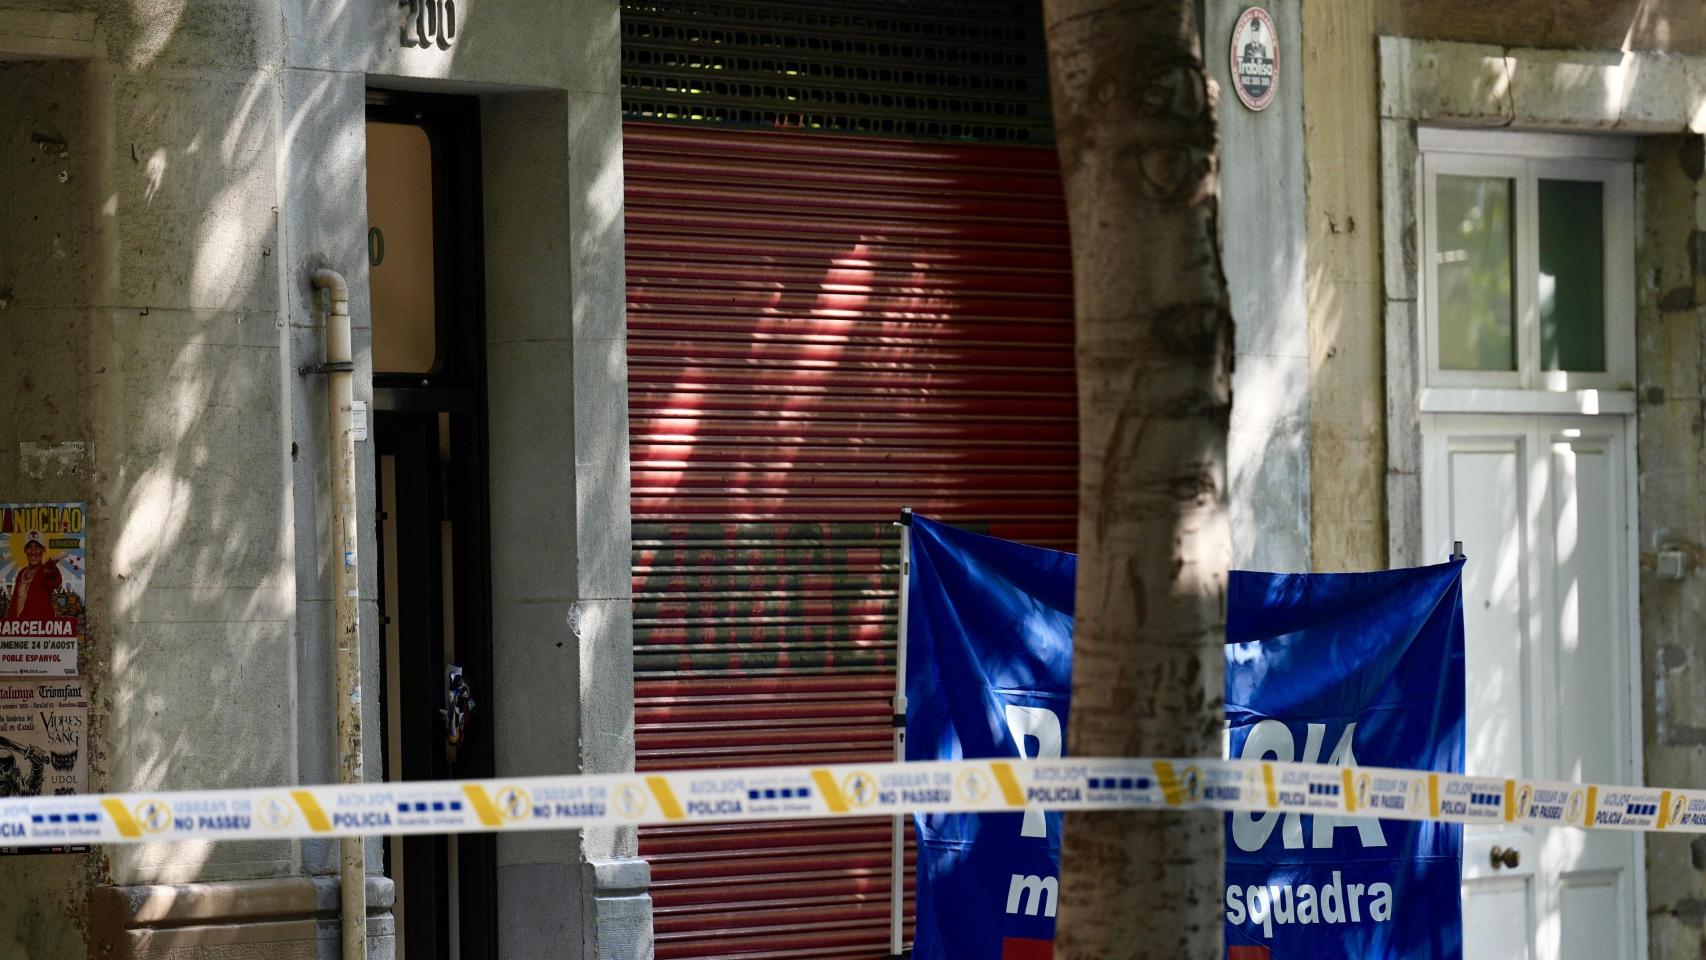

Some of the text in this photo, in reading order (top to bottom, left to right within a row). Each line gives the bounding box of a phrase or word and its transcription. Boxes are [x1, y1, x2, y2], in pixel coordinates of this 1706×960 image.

[398, 0, 455, 51] 200
[0, 620, 72, 635] ARCELONA
[2, 654, 61, 662] POBLE ESPANYOL
[51, 775, 79, 784] UDOL
[1027, 787, 1080, 802] POLICIA
[532, 803, 606, 818] NO PASSEU
[688, 801, 743, 815] POLICIA
[1441, 799, 1466, 815] POLICIA
[1529, 804, 1564, 819] NO PASSEU
[174, 815, 250, 830] NO PASSEU
[333, 812, 391, 827] POLICIA
[1595, 811, 1622, 824] POLICIA
[1680, 813, 1691, 825] NO
